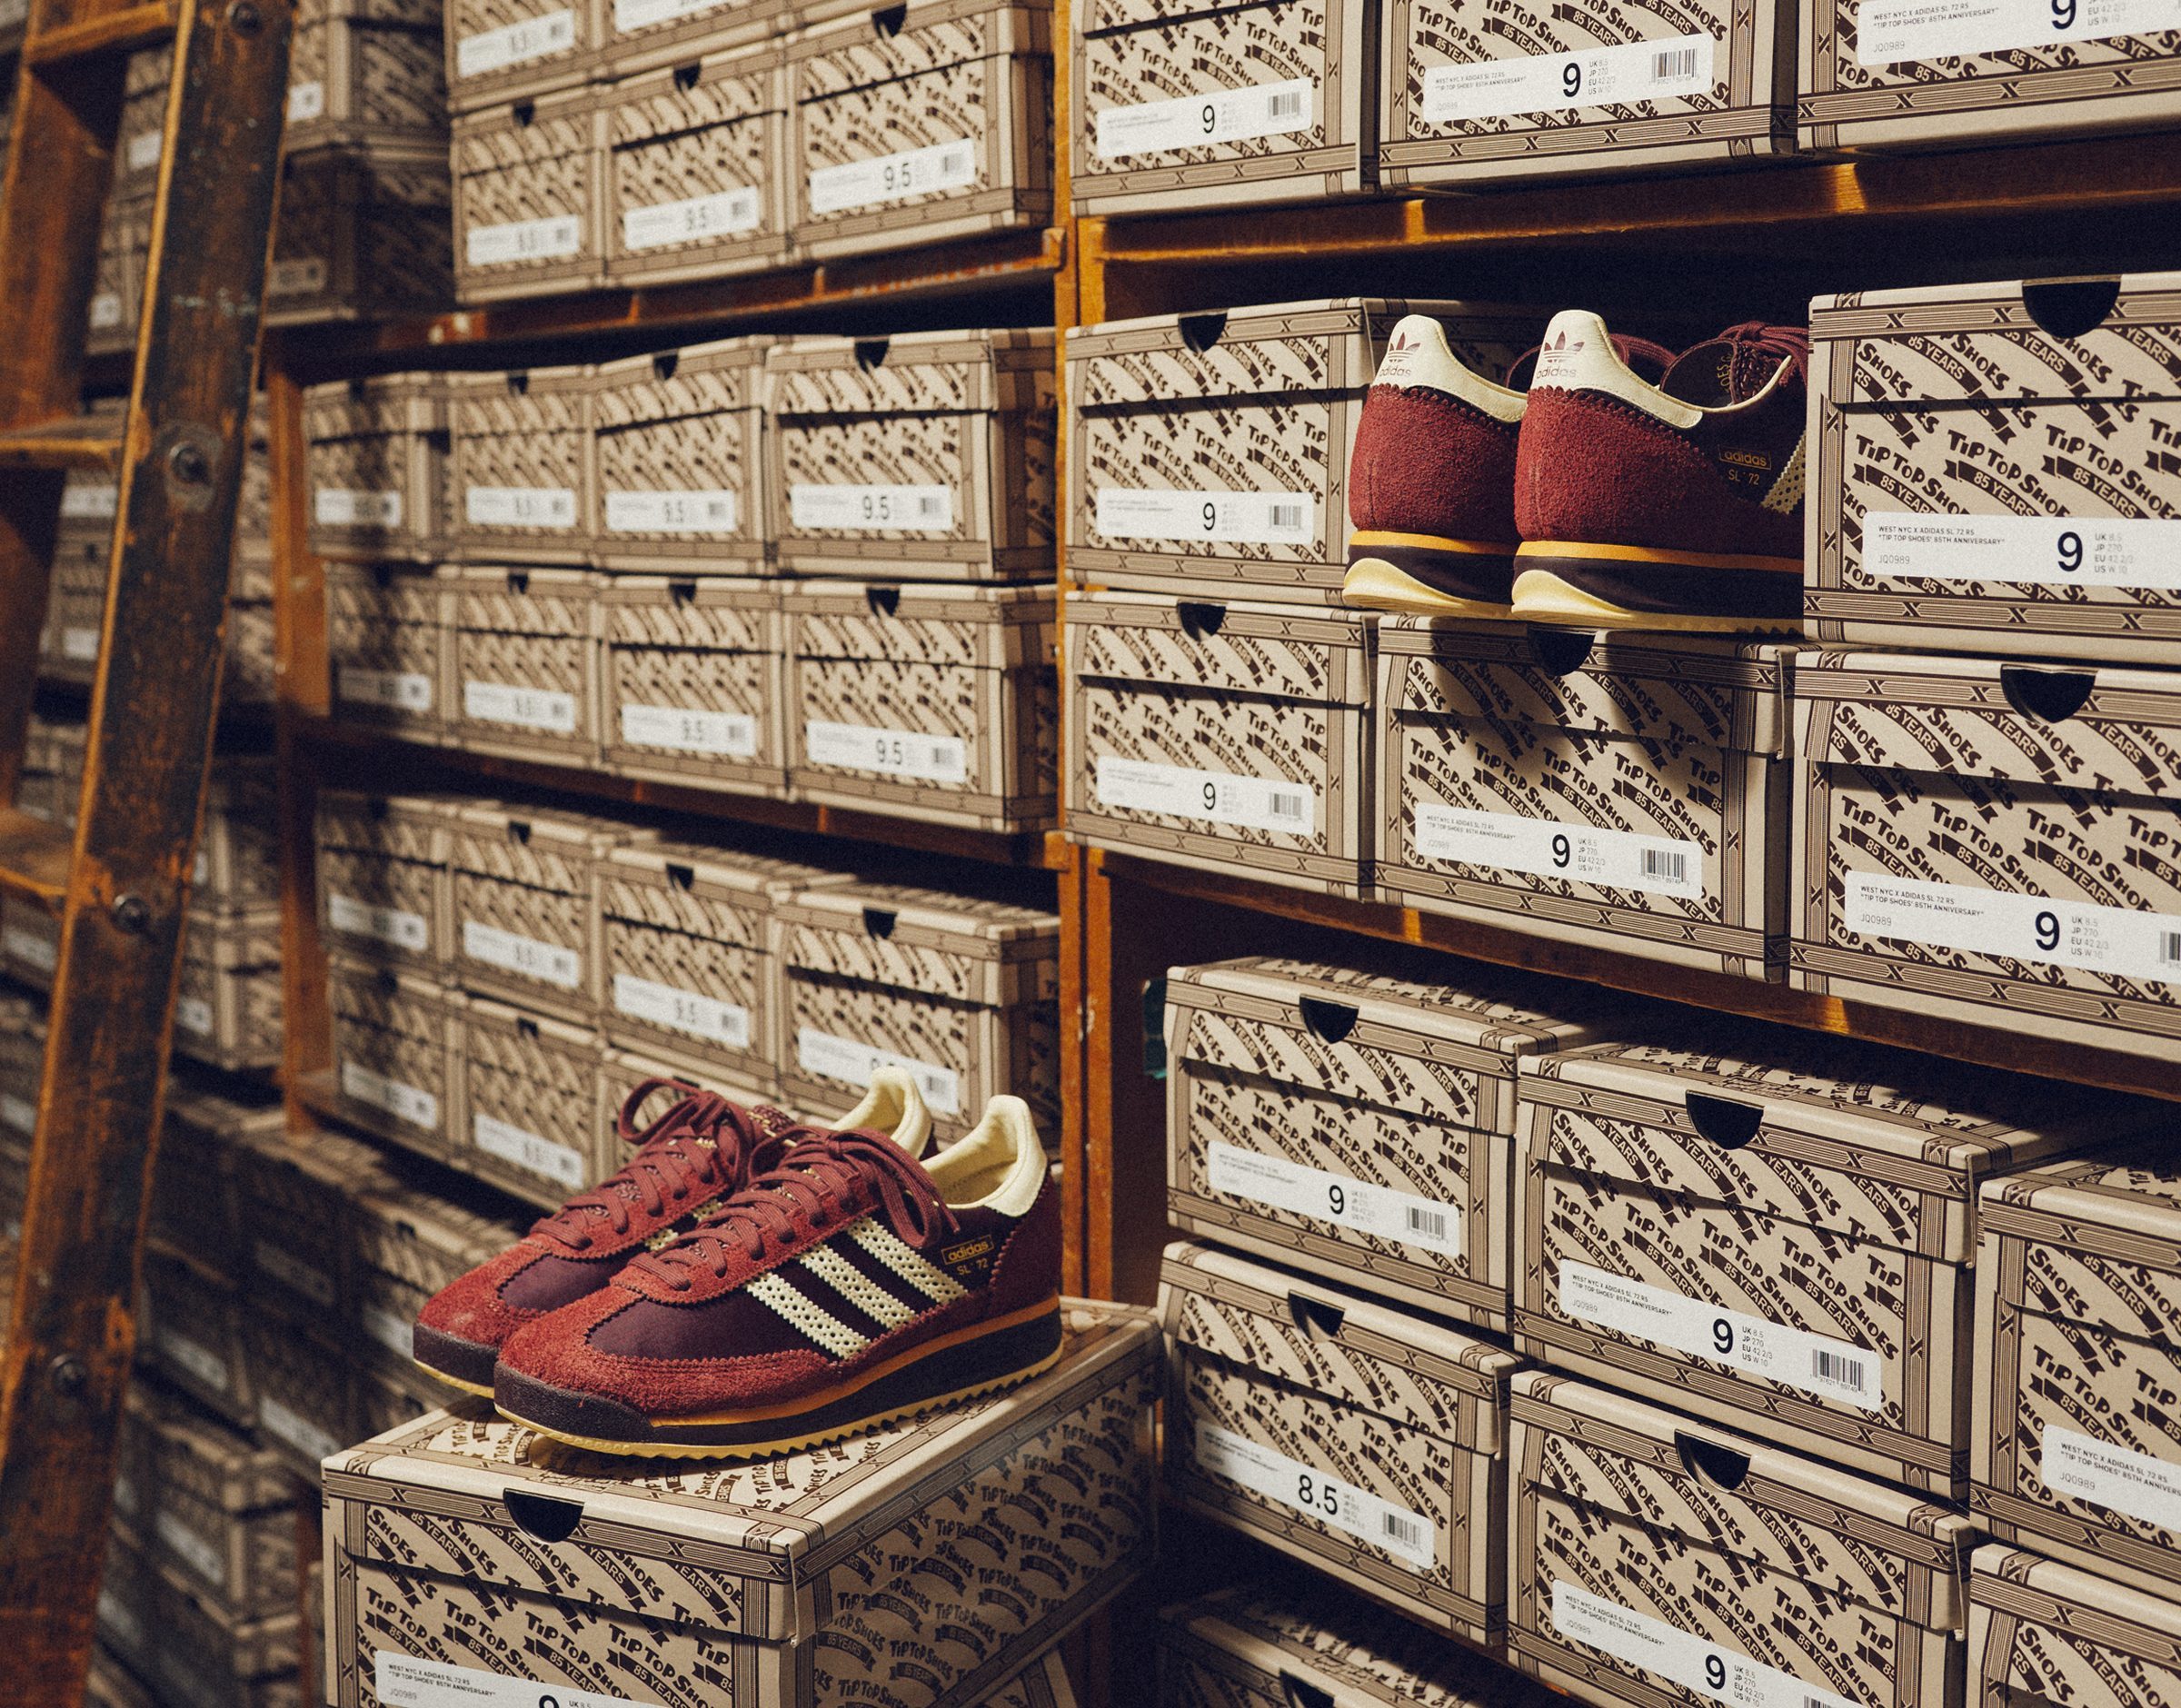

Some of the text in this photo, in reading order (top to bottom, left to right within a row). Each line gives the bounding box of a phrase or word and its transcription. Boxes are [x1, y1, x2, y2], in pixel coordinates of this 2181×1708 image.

[1418, 5, 1469, 41] TIP TOP
[1502, 24, 1515, 37] 85
[1573, 11, 1617, 46] 85 YEARS
[2051, 0, 2076, 29] 9
[1563, 63, 1580, 97] 9
[1202, 104, 1215, 133] 9
[883, 163, 912, 191] 9.5
[1379, 365, 1411, 377] adidas
[1536, 363, 1578, 379] adidas
[1857, 343, 1912, 398] SHOES
[1924, 342, 1966, 380] YEARS
[1952, 334, 2010, 391] SHOES
[2021, 331, 2066, 372] YEARS
[1248, 424, 1323, 504] TIP TOP SHOES
[1725, 451, 1767, 466] adidas
[1857, 434, 1925, 484] TIP TOP
[1947, 430, 2021, 480] TIP TOP
[2047, 424, 2124, 476] TIP TOP
[1729, 470, 1740, 482] SL
[1973, 472, 1990, 489] 85
[2073, 467, 2137, 519] 85 YEARS
[861, 494, 891, 521] 9.5
[1202, 502, 1215, 531] 9
[1878, 555, 1909, 563] JQ0989
[2058, 531, 2082, 571] 9
[1409, 658, 1447, 710] SHOES
[1835, 706, 1887, 764] SHOES
[1900, 712, 1938, 752] YEARS
[1927, 707, 1982, 770] SHOES
[1999, 718, 2039, 756] YEARS
[876, 740, 903, 766] 9.5
[1475, 742, 1527, 791] TIP TOP
[1203, 782, 1216, 810] 9
[1615, 752, 1718, 857] TIP TOP SHOES
[1635, 791, 1684, 839] 85 YEARS
[1841, 796, 1909, 851] TIP TOP
[1931, 801, 2004, 859] TIP TOP
[2026, 809, 2103, 868] TIP TOP
[1552, 834, 1570, 868] 9
[1901, 892, 1925, 900] ADIDAS
[2053, 854, 2117, 907] 85 YEARS
[1861, 914, 1891, 926] JQ0989
[1915, 901, 1932, 909] 85TH
[2036, 911, 2059, 950] 9
[1555, 1113, 1597, 1170] SHOES
[1606, 1123, 1638, 1164] YEARS
[1375, 1117, 1466, 1217] TIP TOP SHOES
[1329, 1185, 1345, 1216] 9
[1625, 1202, 1684, 1258] TIP TOP
[1701, 1218, 1763, 1278] TIP TOP
[949, 1242, 989, 1261] adidas
[1724, 1261, 1775, 1316] 85 YEARS
[1782, 1236, 1898, 1360] TIP TOP SHOES
[1805, 1280, 1859, 1337] 85 YEARS
[1713, 1318, 1734, 1354] 9
[1742, 1326, 1764, 1337] UK 8.5
[1742, 1344, 1772, 1359] EU 42 2/3
[1752, 1338, 1764, 1347] 270
[1742, 1353, 1751, 1361] US
[1760, 1358, 1768, 1366] 10
[1363, 1420, 1447, 1530] TIP TOP SHOES
[2060, 1473, 2095, 1490] JQ0989
[2061, 1443, 2081, 1454] WEST
[2083, 1450, 2097, 1459] NYC
[2107, 1458, 2134, 1472] ADIDAS
[2136, 1467, 2145, 1475] SL
[2158, 1475, 2167, 1483] RS
[1299, 1474, 1339, 1515] 8.5
[369, 1508, 417, 1564] SHOES
[411, 1509, 462, 1560] 85 YEARS
[448, 1514, 499, 1576] SHOES
[366, 1586, 427, 1640] TIP TOP
[444, 1599, 508, 1653] TIP TOP
[1773, 1586, 1806, 1620] TIP
[1808, 1615, 1837, 1653] TOP
[525, 1611, 591, 1668] TIP TOP
[1706, 1654, 1726, 1690] 9
[1797, 1634, 1849, 1695] 85 YEARS
